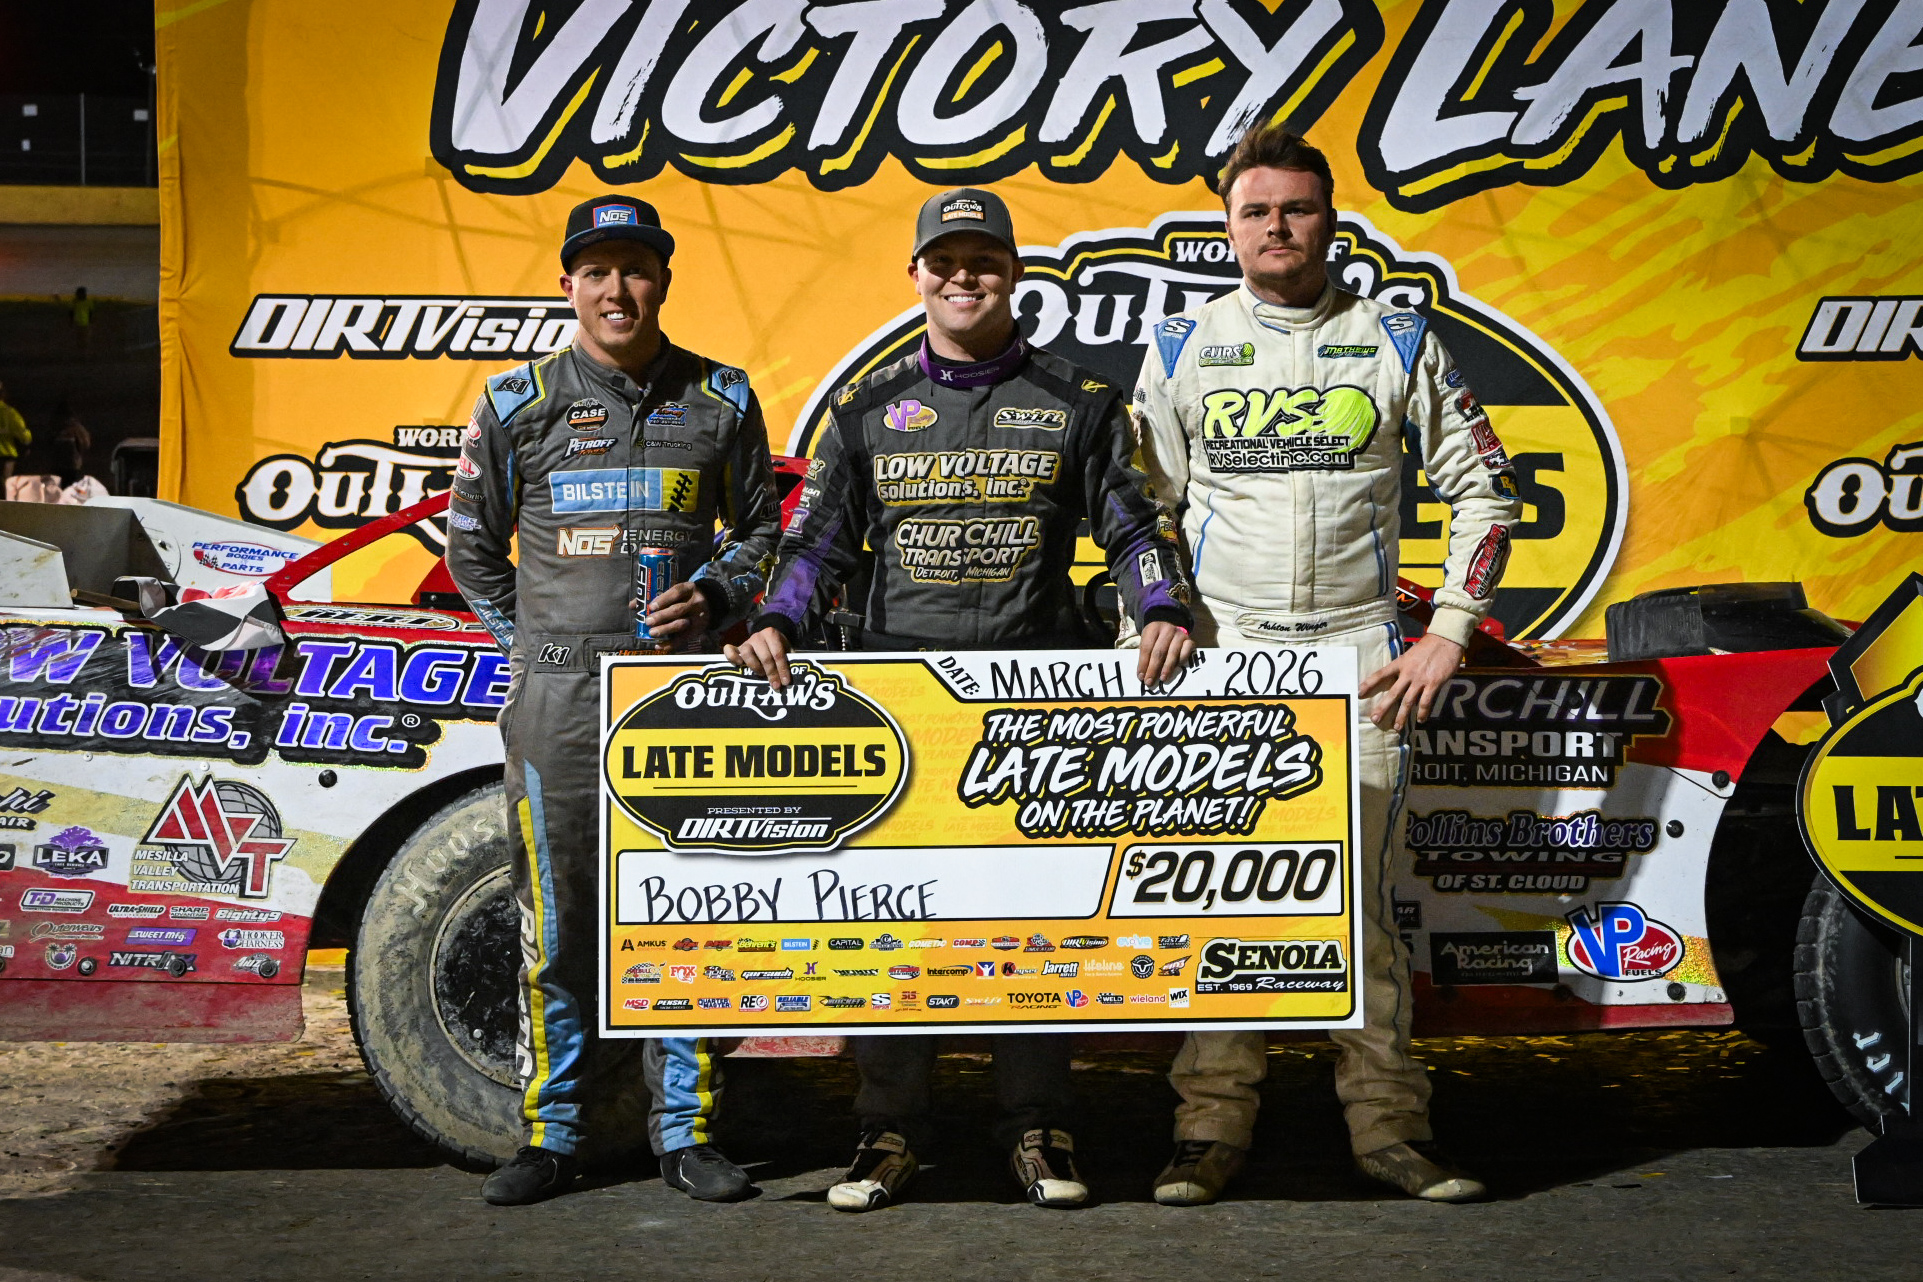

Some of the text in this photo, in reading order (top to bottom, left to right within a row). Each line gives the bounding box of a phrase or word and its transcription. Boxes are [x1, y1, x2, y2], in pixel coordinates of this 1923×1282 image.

[451, 0, 1923, 173] VICTORY LANE
[600, 209, 632, 222] NOS
[234, 298, 579, 353] DIRTVisio
[954, 367, 1000, 379] HOOSIER
[571, 408, 606, 419] CASE
[398, 428, 467, 447] WOR
[1206, 438, 1269, 450] RECREATIONAL
[1313, 436, 1350, 447] SELECT
[564, 438, 616, 458] PETROFF
[876, 451, 1057, 480] LOW VOLTAGE
[562, 480, 650, 502] BILSTEIN
[880, 479, 980, 499] solutions,
[192, 541, 300, 560] PERFORMANCE
[558, 524, 624, 558] NOS
[622, 529, 694, 541] ENERGY
[226, 552, 265, 561] BODIES
[221, 562, 265, 573] PARTS
[965, 567, 1011, 578] MICHIGAN
[1257, 620, 1328, 633] Ashton Winger
[537, 642, 571, 665] K1
[790, 665, 807, 676] OF
[937, 656, 982, 697] DATE:
[989, 648, 1323, 699] MARCH 2026
[1430, 679, 1659, 721] RCHILL
[0, 692, 252, 748] utions,
[987, 708, 1290, 743] THE MOST POWERFUL
[1411, 730, 1624, 758] ANSPORT
[622, 743, 887, 779] LATE MODELS
[963, 741, 1313, 798] LATE MODELS
[1411, 763, 1609, 782] ROIT, MICHIGAN
[707, 806, 802, 815] PRESENTED BY
[1020, 797, 1256, 828] ON THE PLANET!
[1832, 784, 1923, 841] LA
[0, 817, 30, 828] AIR
[1507, 813, 1655, 848] Brothers
[36, 848, 104, 866] LEKA
[134, 849, 190, 862] MESILLA
[1420, 850, 1624, 863] TOWING
[132, 864, 181, 877] VALLEY
[1125, 848, 1337, 911] $20,000
[131, 879, 240, 895] TRANSPORTATION
[1437, 874, 1588, 890] OF ST. CLOUD
[639, 869, 938, 923] BOBBY PIERCE
[241, 931, 283, 941] HOOKER
[241, 940, 284, 948] HARNESS
[1567, 903, 1645, 978] VP
[1440, 940, 1549, 957] American
[1622, 942, 1677, 966] Racing
[670, 965, 697, 978] FOX
[927, 967, 969, 977] Intercomp
[1042, 960, 1080, 975] Jarrett
[1202, 940, 1344, 979] SENOIA
[1456, 955, 1533, 976] Racing
[1624, 968, 1663, 977] FUELS
[1197, 975, 1346, 992] EST. 1969 Raceway
[625, 999, 649, 1007] MSD
[1007, 992, 1062, 1004] TOYOTA
[1101, 995, 1124, 1003] WELD
[1129, 994, 1166, 1004] wieland
[1169, 989, 1188, 1001] WIX
